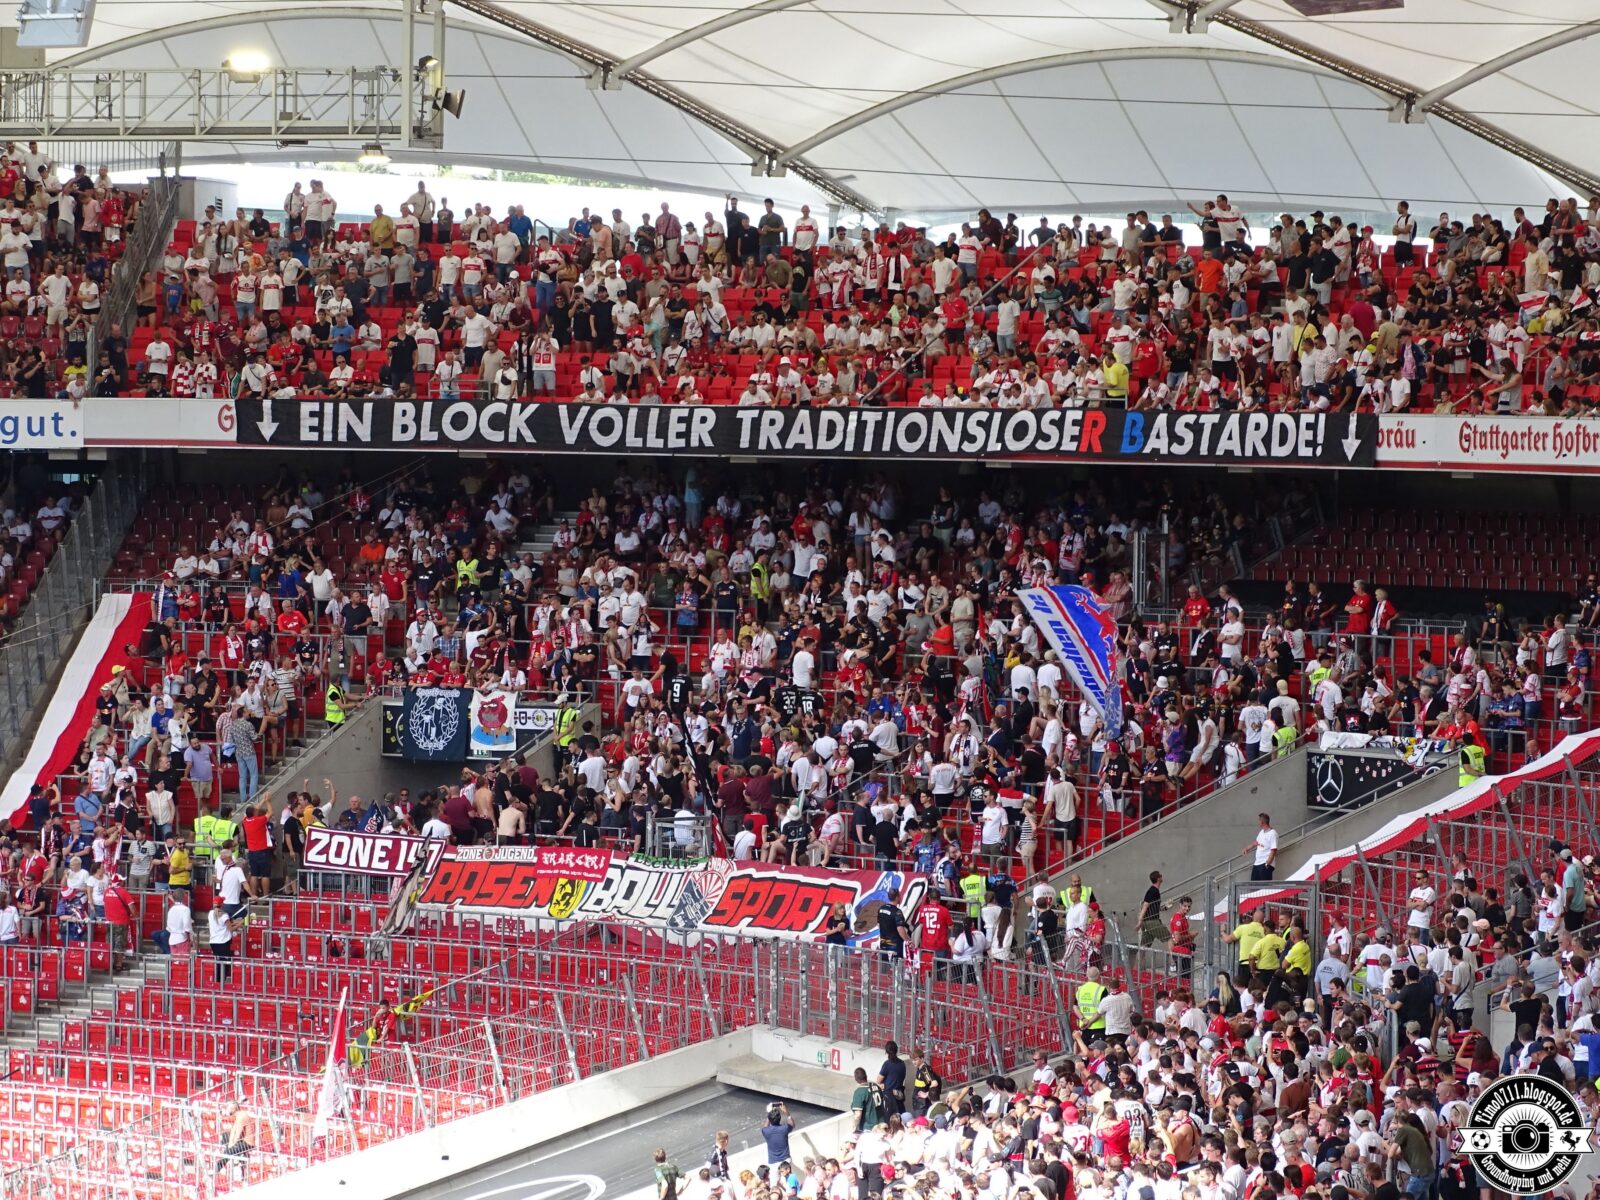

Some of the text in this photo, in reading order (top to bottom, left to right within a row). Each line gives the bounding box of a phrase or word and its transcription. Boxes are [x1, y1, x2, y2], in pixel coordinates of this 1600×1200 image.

[0, 411, 77, 444] gut.
[300, 402, 1326, 457] EIN BLOCK VOLLER TRADITIONSLOSER BASTARDE!
[309, 832, 393, 870] ZONE
[457, 848, 535, 860] ZONE JUGEND
[832, 1051, 839, 1069] 4
